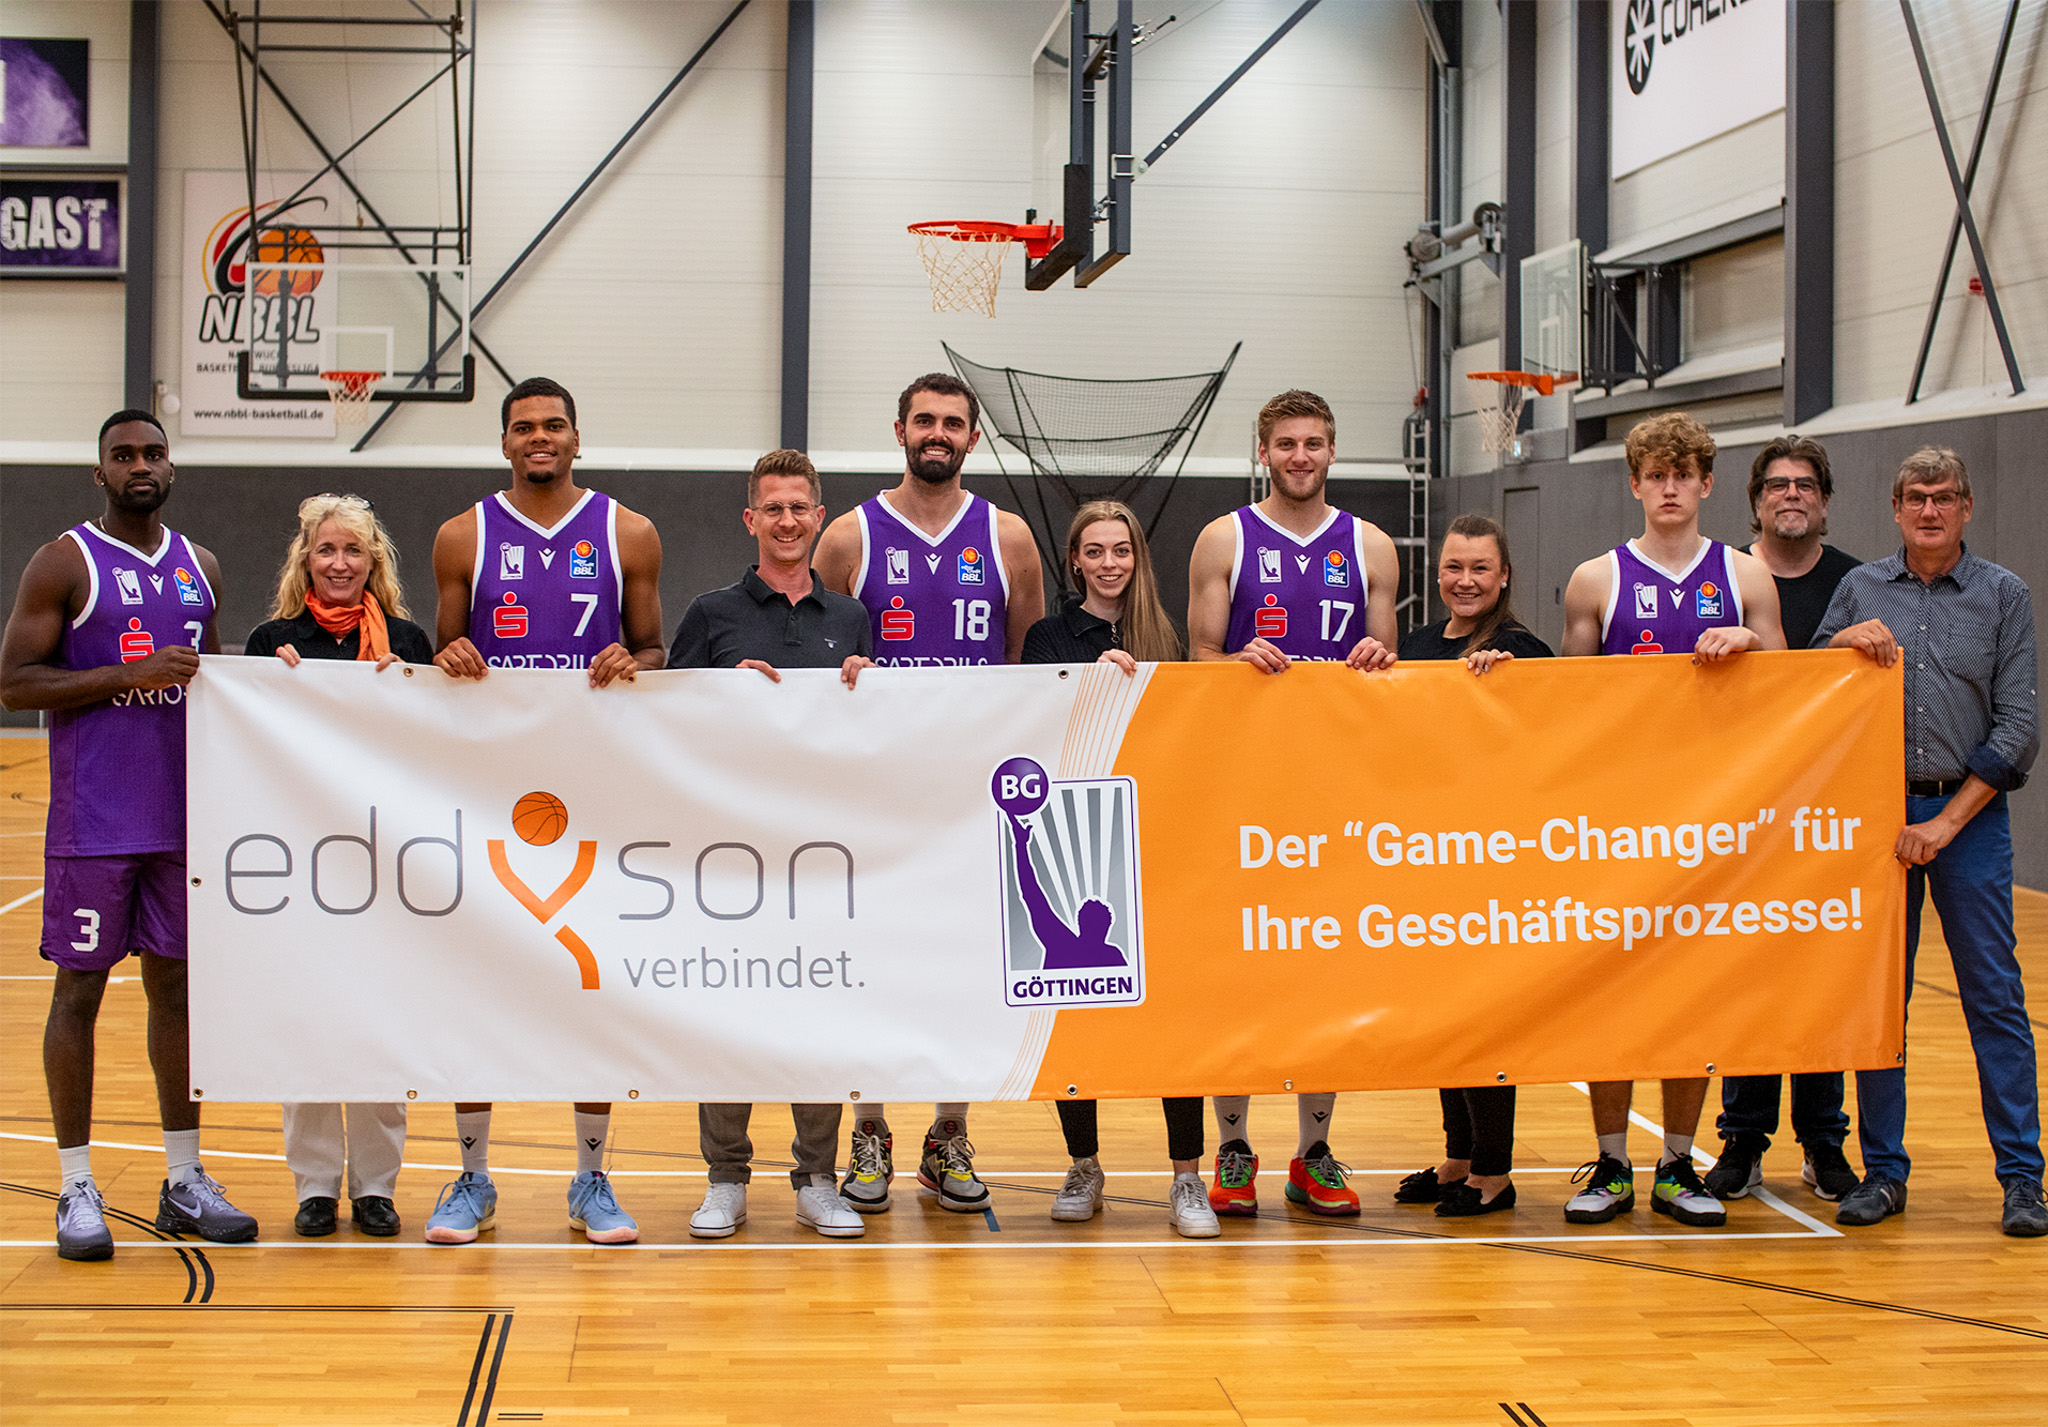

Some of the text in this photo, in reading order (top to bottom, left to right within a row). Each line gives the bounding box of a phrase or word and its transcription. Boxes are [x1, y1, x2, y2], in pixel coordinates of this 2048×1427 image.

[1661, 0, 1750, 45] COHE
[0, 196, 107, 250] GAST
[199, 295, 320, 343] NBBL
[194, 409, 324, 419] www.nbbl-basketball.de
[571, 593, 598, 637] 7
[952, 599, 991, 641] 18
[1319, 600, 1355, 642] 17
[184, 621, 203, 654] 3
[487, 654, 598, 669] SARTORIU
[1001, 774, 1041, 800] BG
[1239, 806, 1861, 868] Der “Game-Changer” für
[71, 908, 100, 952] 3
[1241, 888, 1863, 951] Ihre Geschäftsprozesse!
[623, 946, 866, 989] verbindet.
[1013, 976, 1133, 998] GÖTTINGEN
